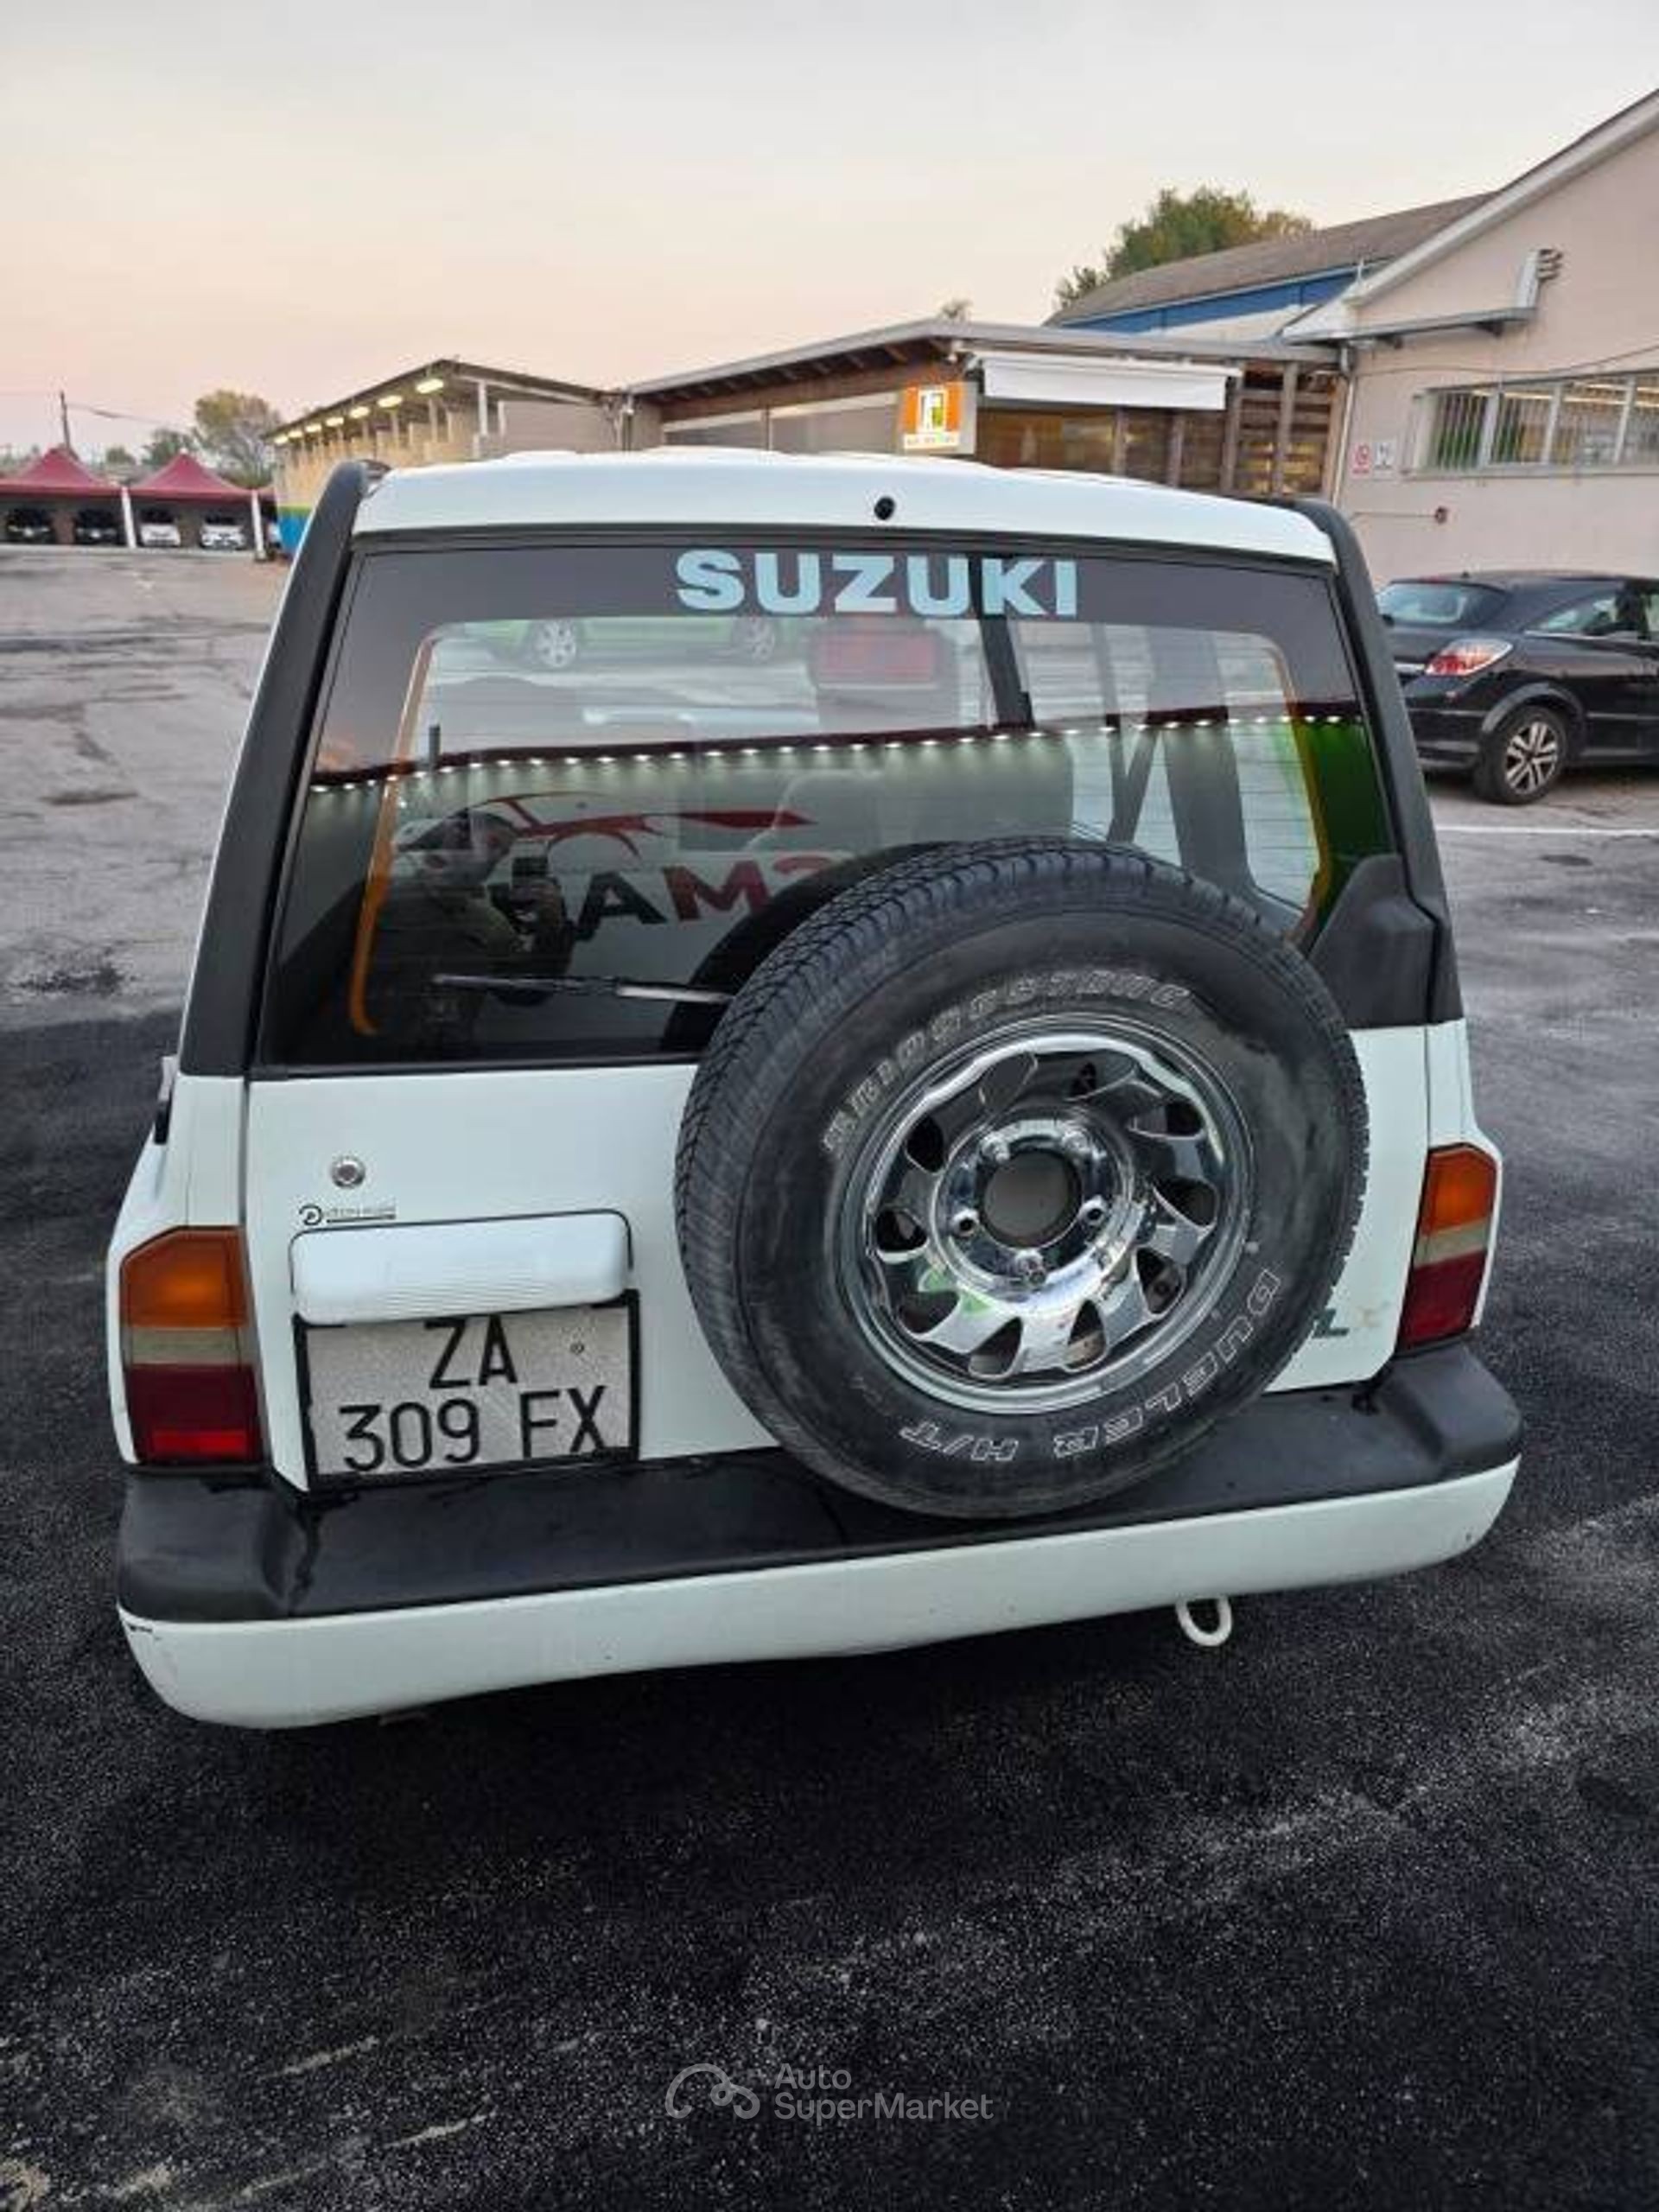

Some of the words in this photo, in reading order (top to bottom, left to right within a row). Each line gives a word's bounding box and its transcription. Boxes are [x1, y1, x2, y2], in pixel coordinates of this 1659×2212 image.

[676, 550, 1077, 616] SUZUKI
[823, 969, 1191, 1153] BRIDGESTONE
[424, 1313, 518, 1389] ZA
[1053, 1268, 1281, 1459] DUELER
[339, 1396, 480, 1471] 309
[520, 1384, 607, 1459] FX
[899, 1421, 1020, 1461] H/T
